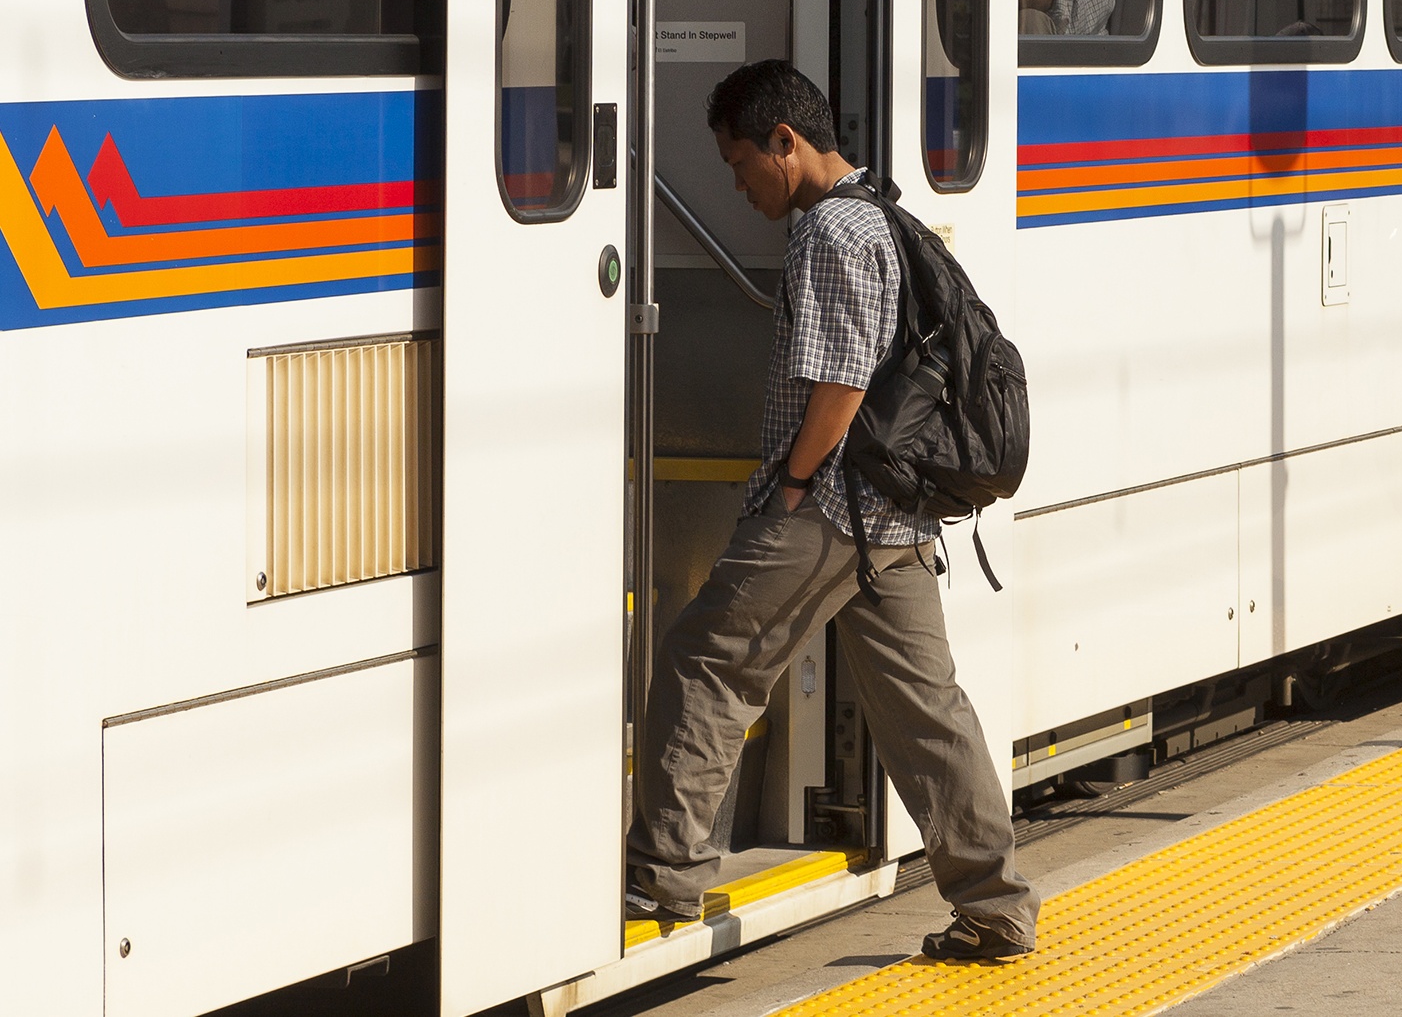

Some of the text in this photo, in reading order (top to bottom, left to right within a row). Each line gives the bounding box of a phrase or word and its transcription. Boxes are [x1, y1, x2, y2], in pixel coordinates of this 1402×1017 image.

[660, 30, 686, 40] Stand
[688, 31, 697, 40] In
[699, 30, 737, 41] Stepwell
